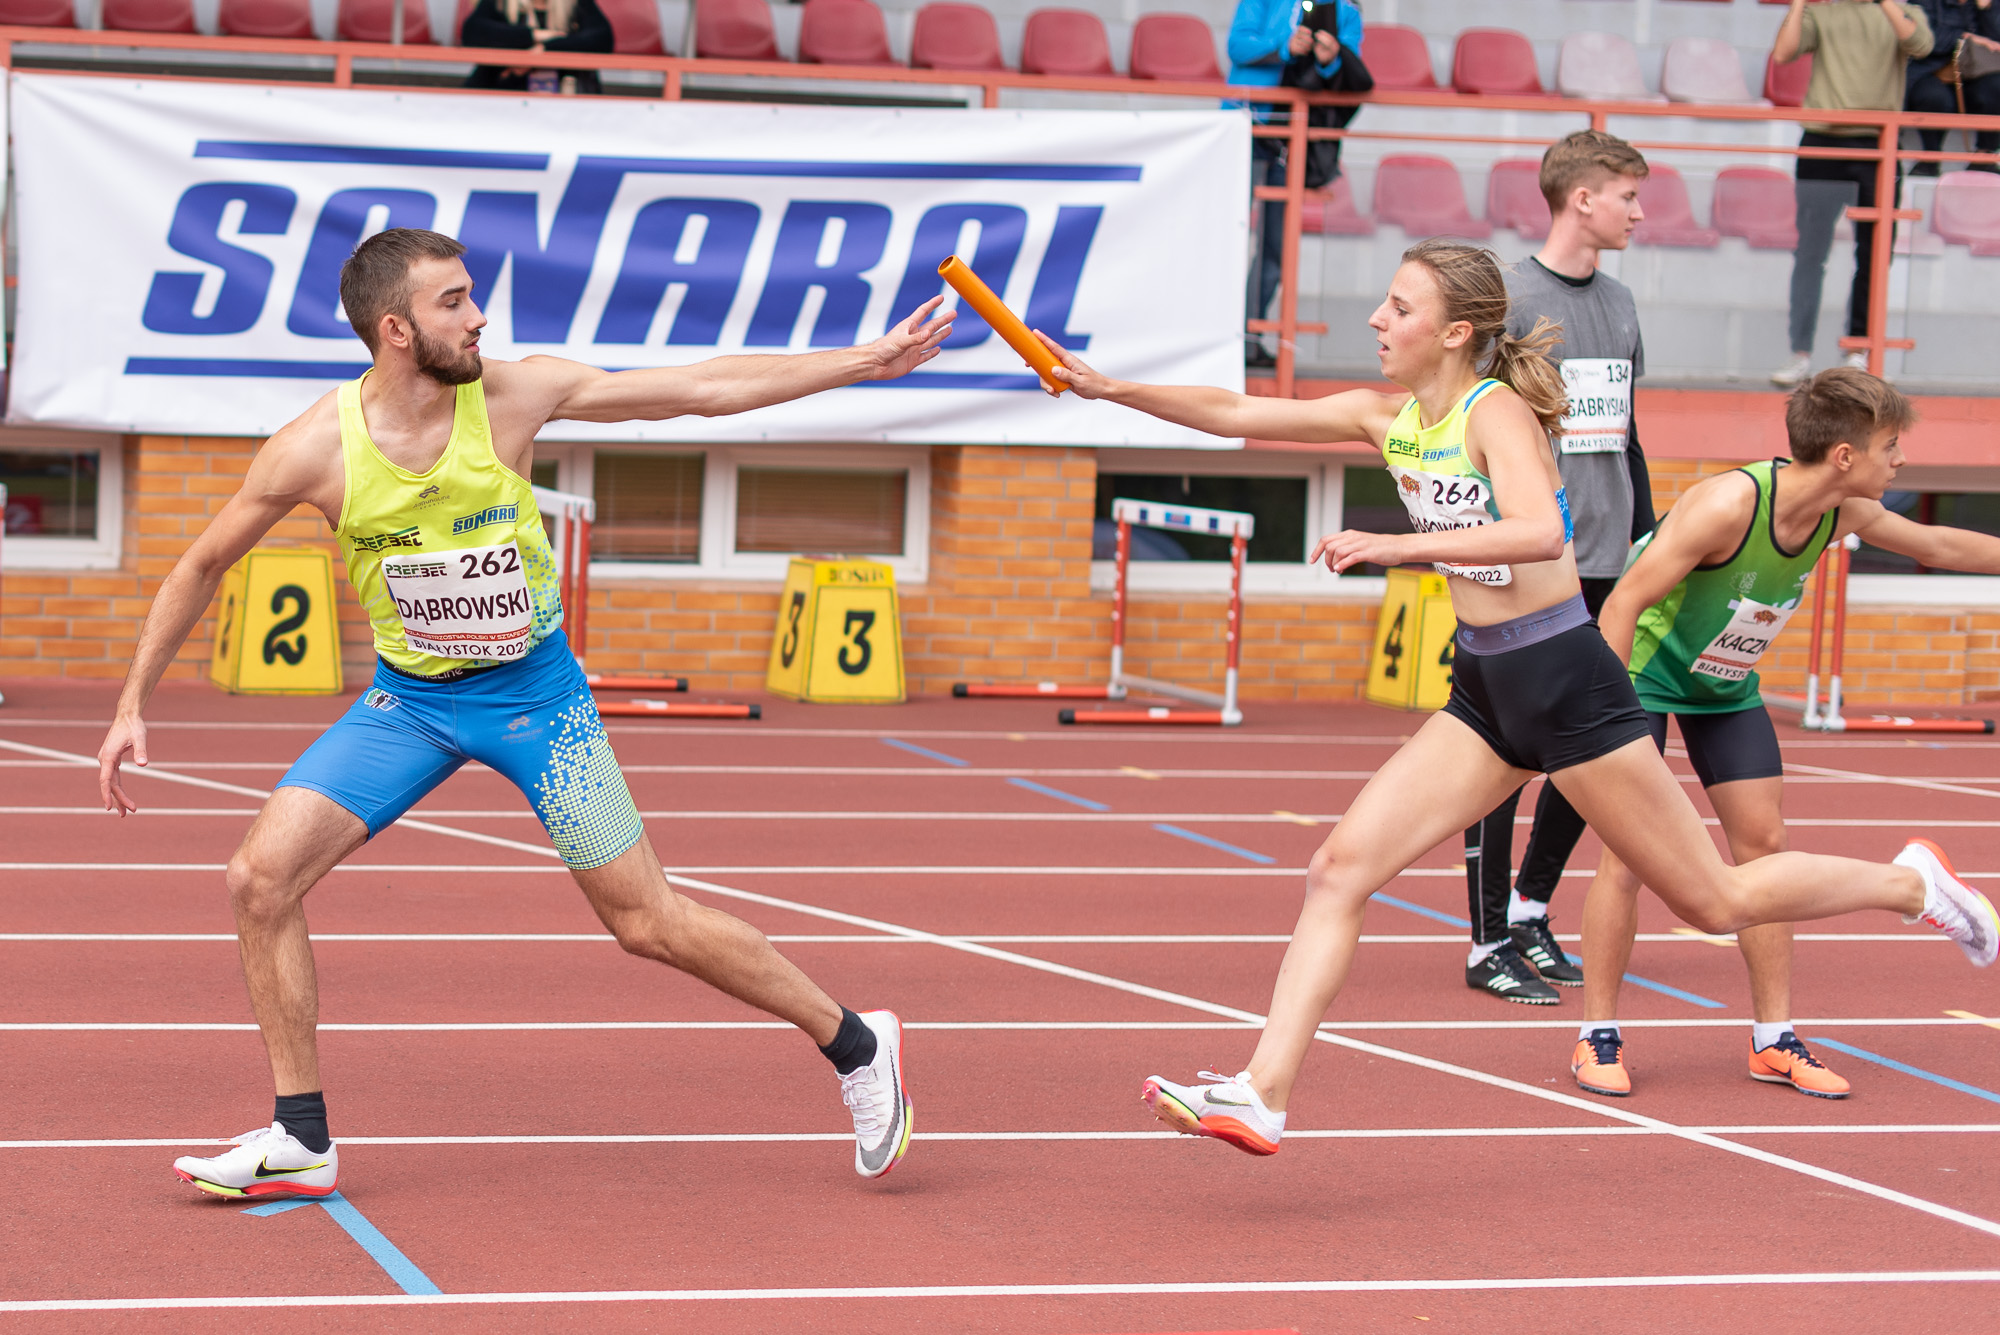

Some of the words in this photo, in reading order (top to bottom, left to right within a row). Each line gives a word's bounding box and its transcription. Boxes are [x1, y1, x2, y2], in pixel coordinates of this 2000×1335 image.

[141, 155, 1104, 351] SONAROL
[1606, 363, 1629, 383] 134
[1432, 479, 1480, 505] 264
[385, 561, 448, 579] PREFBET
[459, 547, 520, 580] 262
[1469, 569, 1503, 582] 2022
[396, 586, 531, 626] DĄBROWSKI
[262, 583, 311, 666] 2
[781, 591, 806, 670] 3
[1384, 602, 1407, 679] 4
[413, 639, 493, 656] BIAŁYSTOK
[838, 610, 876, 676] 3
